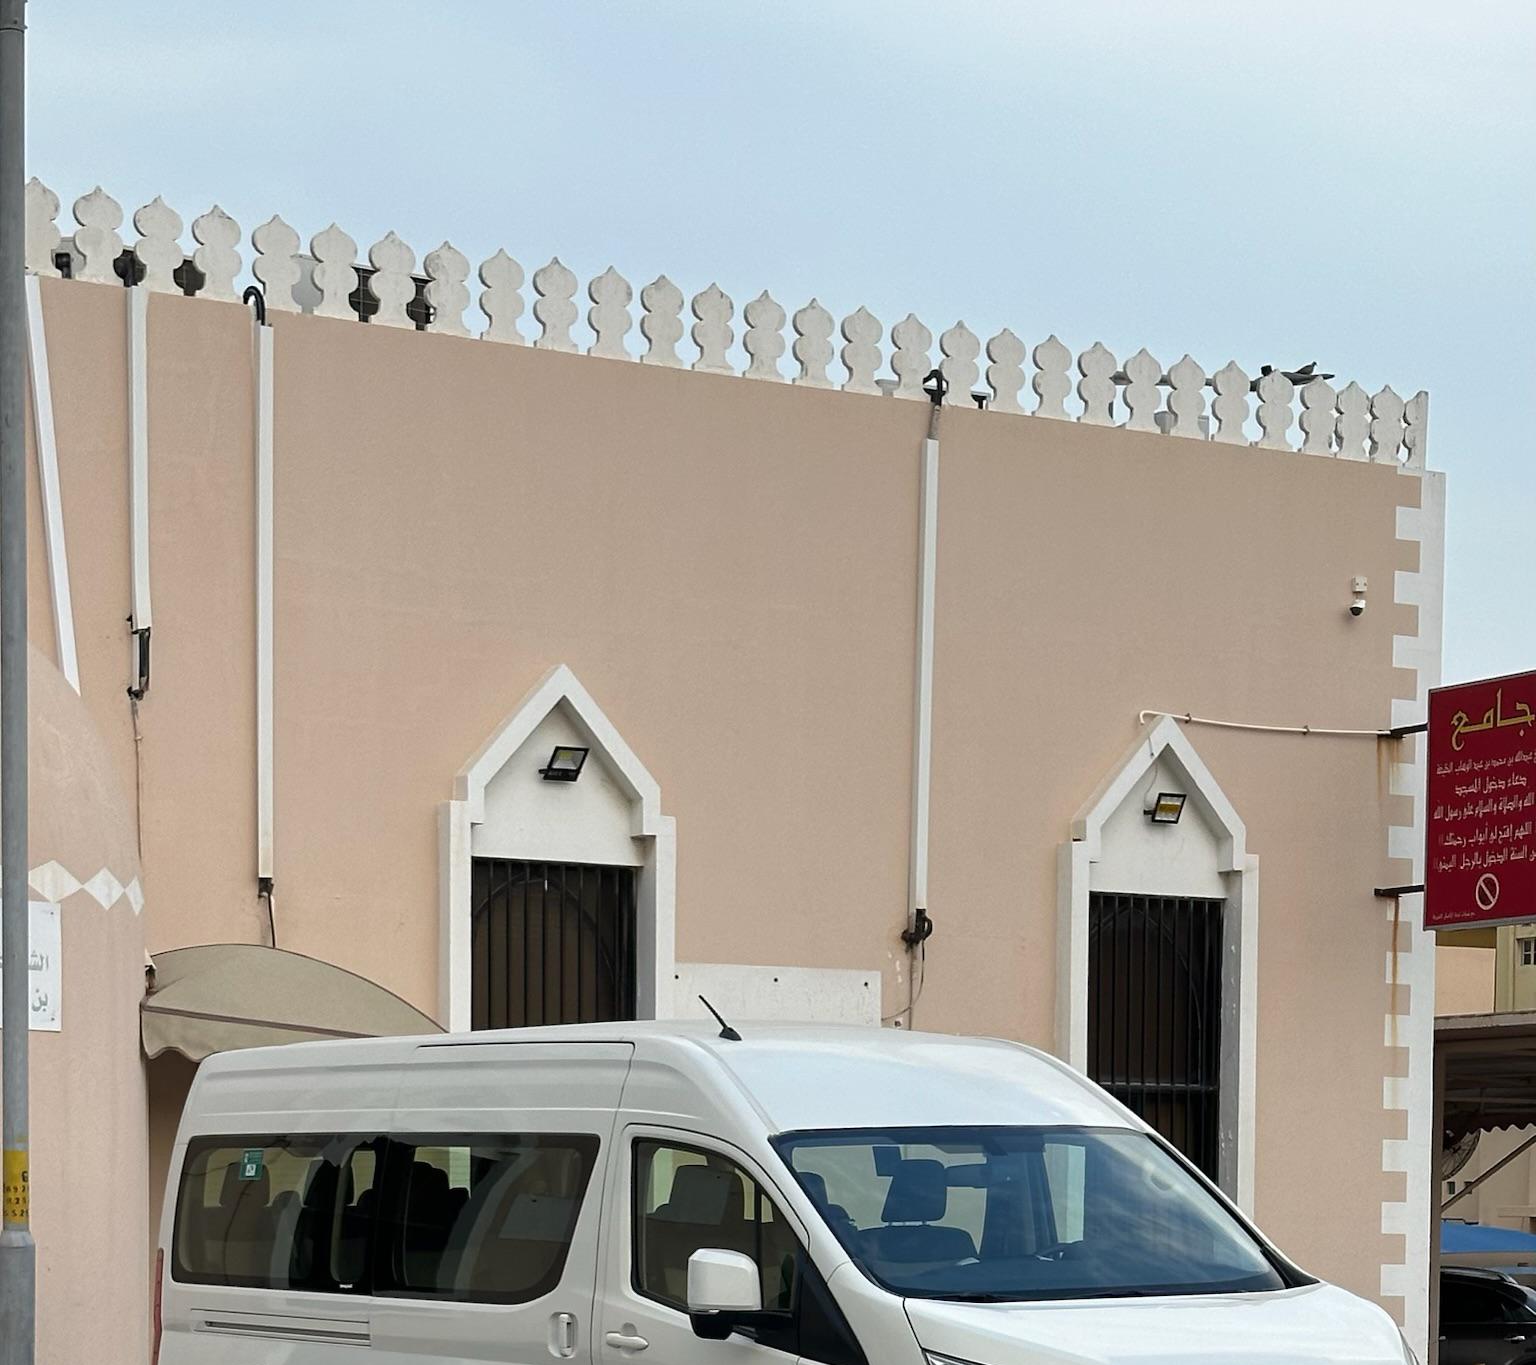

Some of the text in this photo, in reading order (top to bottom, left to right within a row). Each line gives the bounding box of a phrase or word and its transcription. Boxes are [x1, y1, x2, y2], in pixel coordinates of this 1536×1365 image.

[1450, 688, 1535, 751] جامع
[1455, 771, 1527, 798] دعاء دخول المسجد
[1523, 791, 1535, 806] الله
[1433, 799, 1444, 820] الله
[1445, 804, 1462, 822] رسول
[1510, 844, 1528, 860] السنة
[28, 949, 49, 971] الش
[31, 988, 49, 1013] بن
